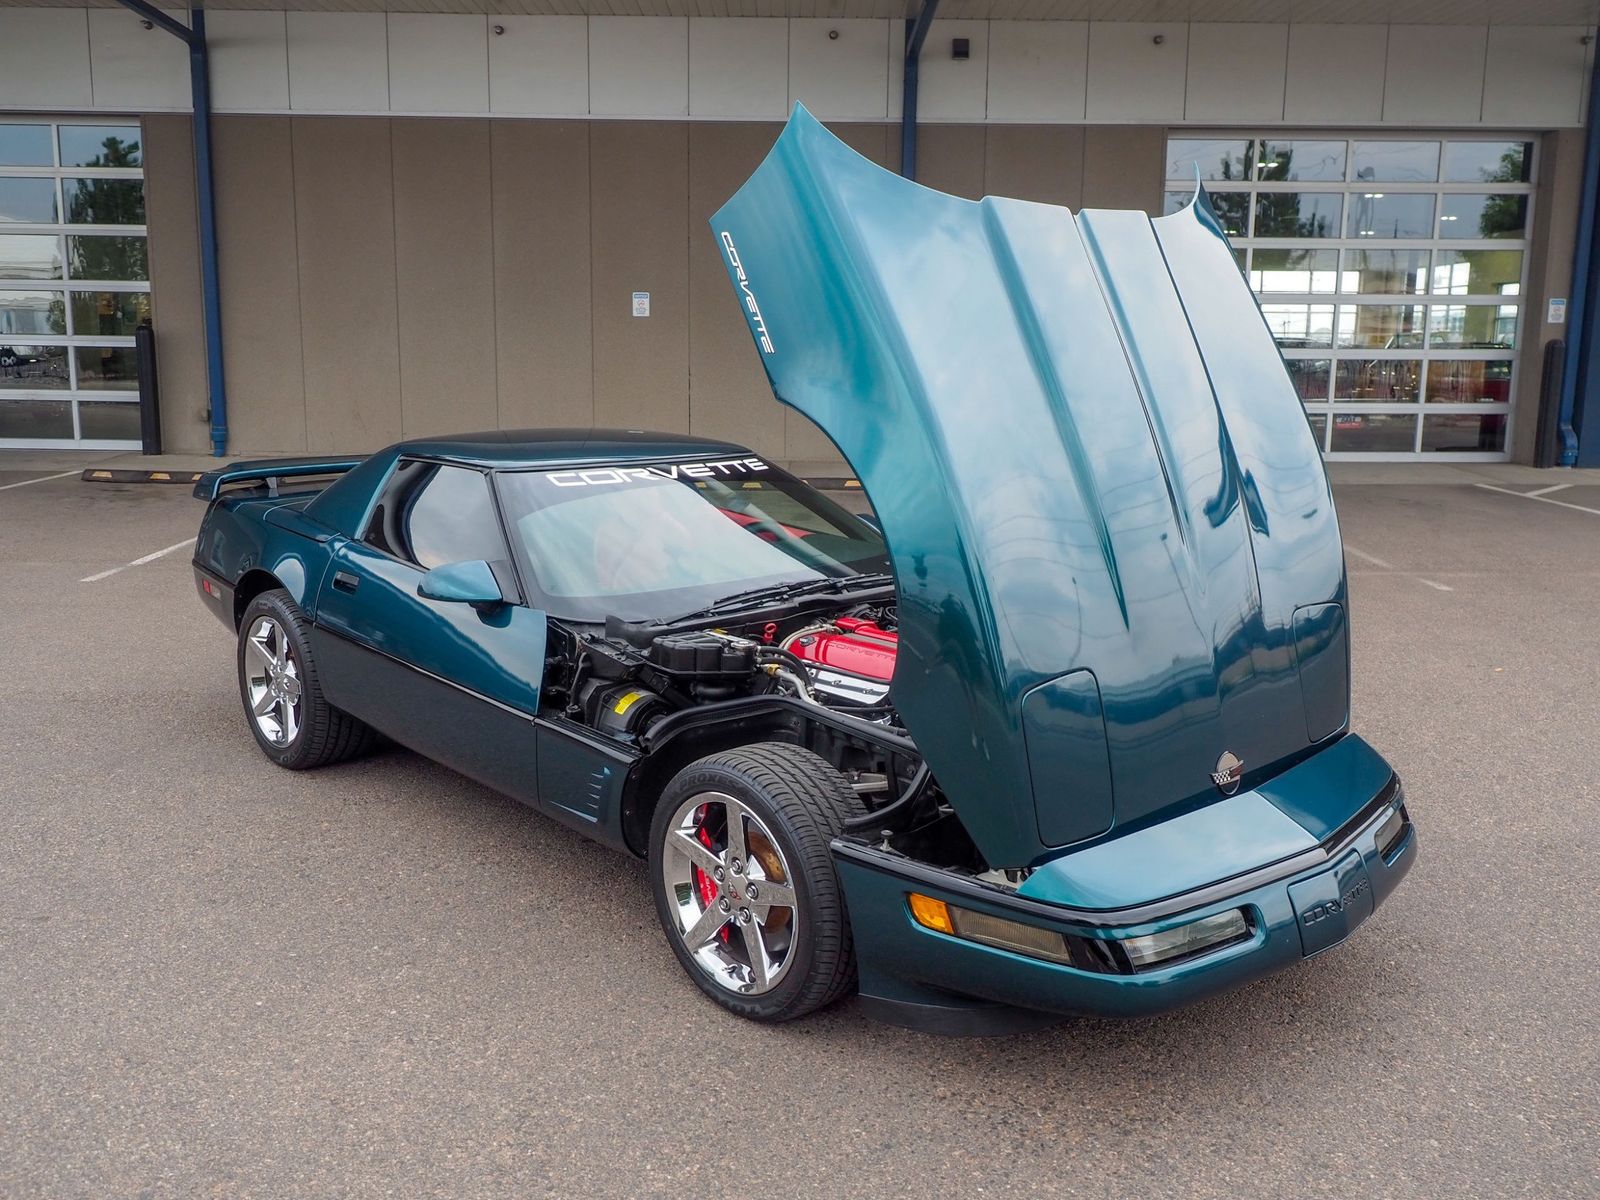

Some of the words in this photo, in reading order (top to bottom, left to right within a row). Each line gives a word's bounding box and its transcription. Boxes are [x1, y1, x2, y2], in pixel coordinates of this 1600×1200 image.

[721, 232, 775, 353] CORVETTE
[546, 458, 768, 487] CORVETTE
[1303, 877, 1367, 926] CORVETTE
